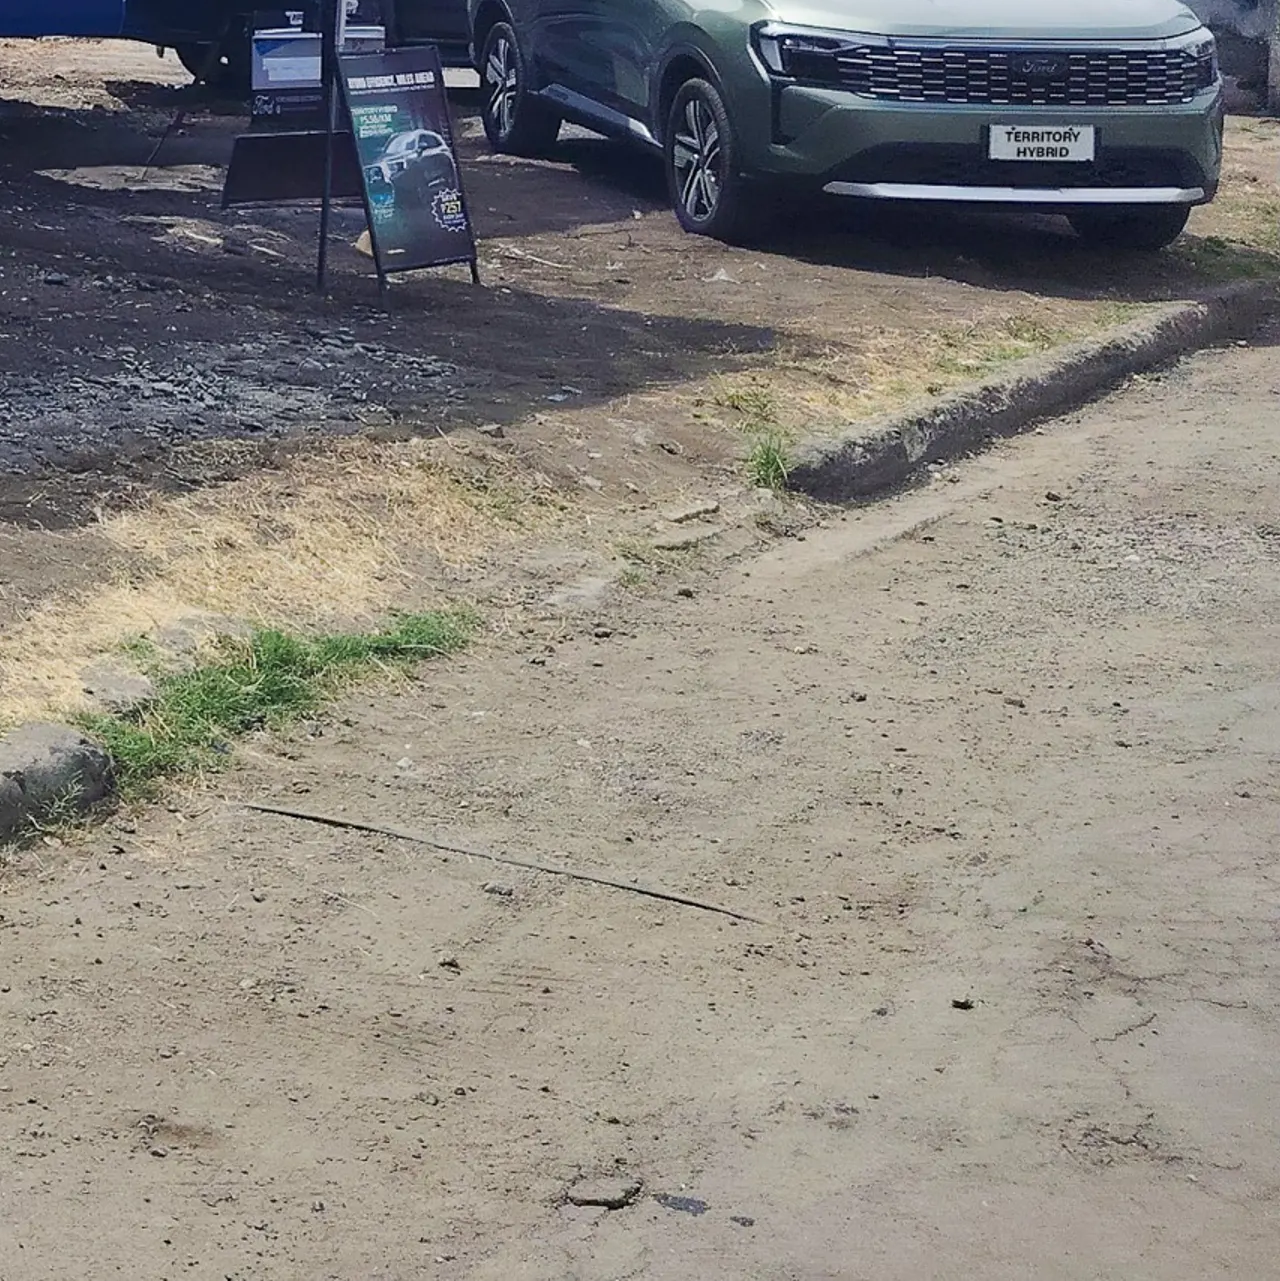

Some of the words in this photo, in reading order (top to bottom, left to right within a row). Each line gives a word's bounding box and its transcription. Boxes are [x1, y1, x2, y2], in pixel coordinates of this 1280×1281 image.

[1022, 59, 1058, 73] Ford
[1005, 131, 1081, 142] TERRITORY
[1016, 146, 1070, 158] HYBRID
